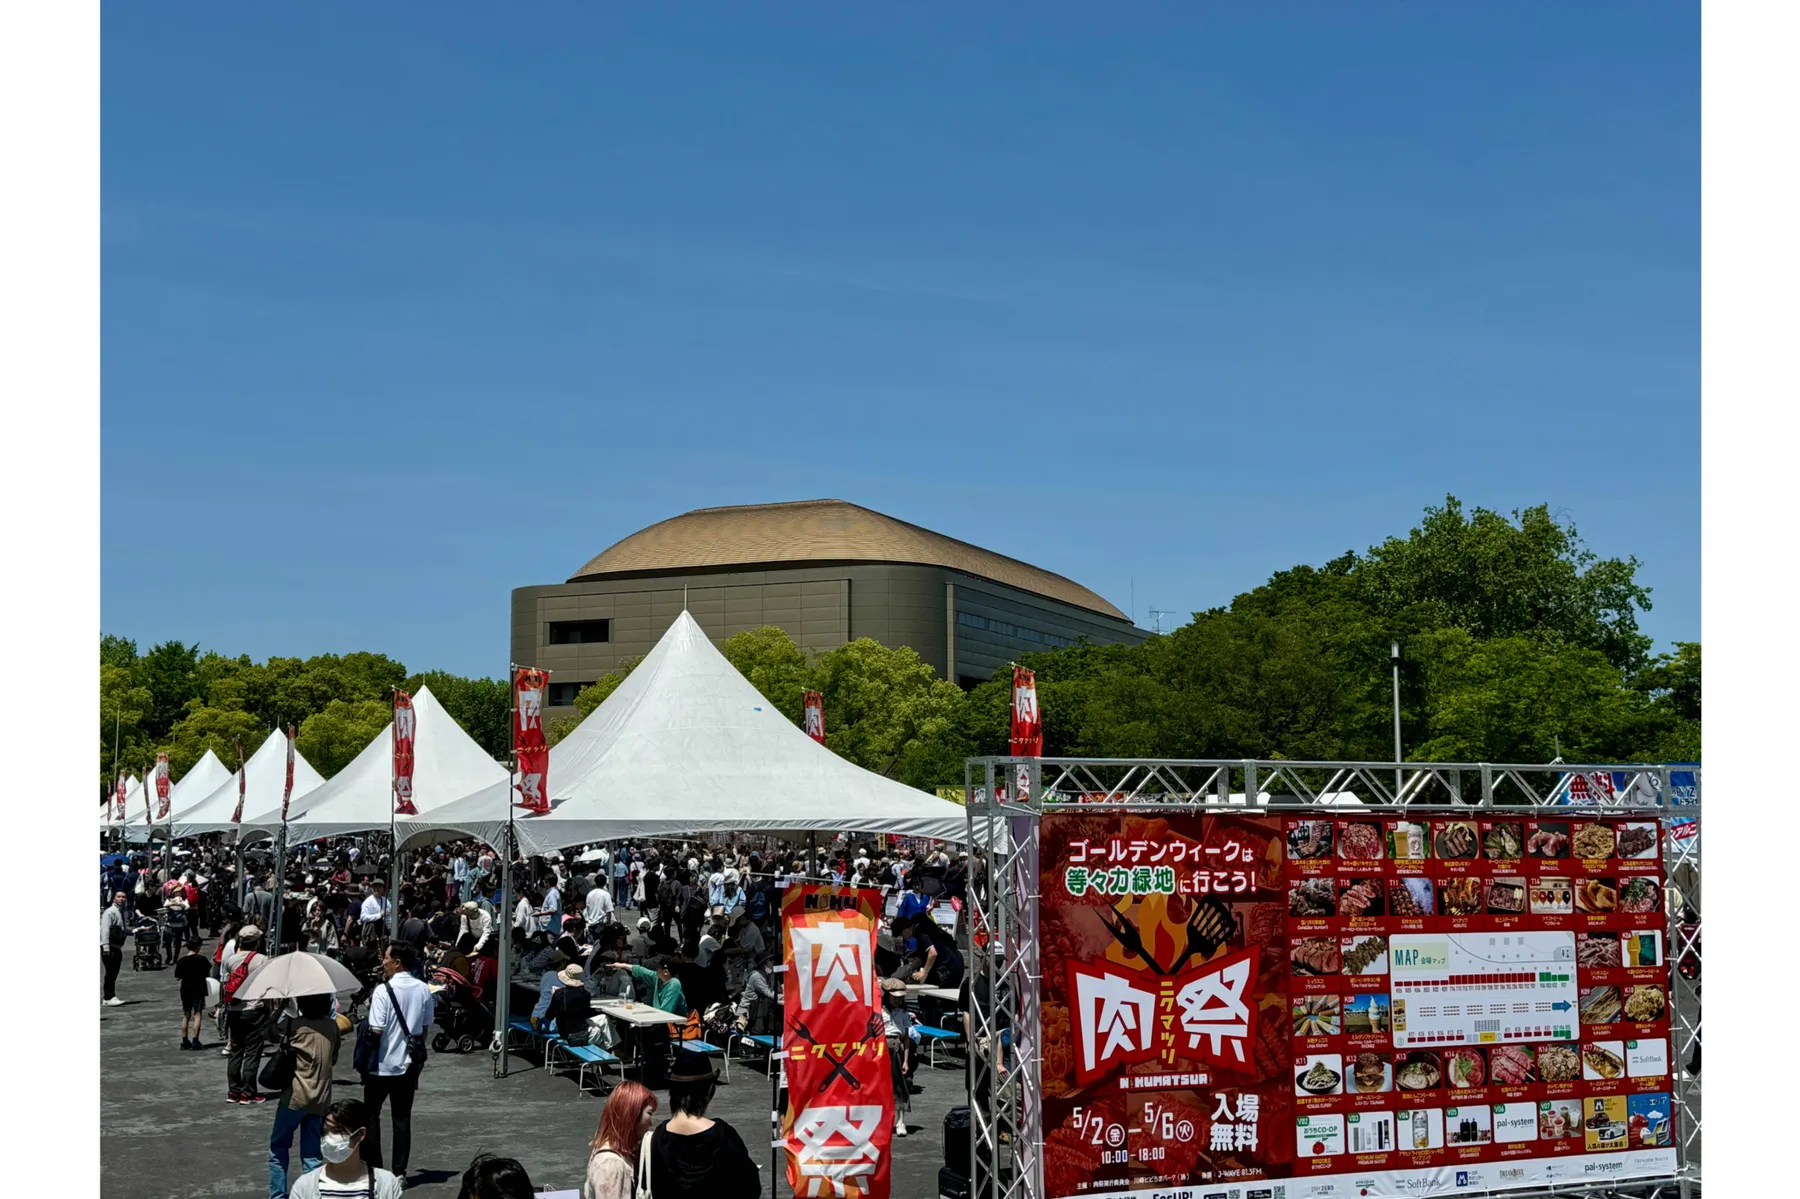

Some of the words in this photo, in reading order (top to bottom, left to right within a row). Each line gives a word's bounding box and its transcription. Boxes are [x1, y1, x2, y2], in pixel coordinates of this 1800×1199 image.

[1069, 838, 1253, 862] ゴールデンウィークは
[789, 921, 872, 1010] 肉
[1394, 949, 1419, 966] MAP
[1420, 957, 1446, 965] 会場マップ
[1075, 972, 1156, 1072] 肉
[1159, 981, 1176, 1065] ニクマツリ
[1175, 957, 1251, 1063] 祭
[790, 1041, 884, 1060] ニクマツリ
[1639, 1055, 1662, 1064] SoftBank
[1144, 1102, 1174, 1139] 5/6
[1211, 1092, 1259, 1122] 入場
[1072, 1106, 1104, 1145] 5/2
[1210, 1122, 1259, 1152] 無料
[794, 1104, 883, 1198] 祭
[1101, 1149, 1128, 1164] 10:00
[1138, 1147, 1165, 1161] 18:00
[1407, 1177, 1441, 1189] SoftBank
